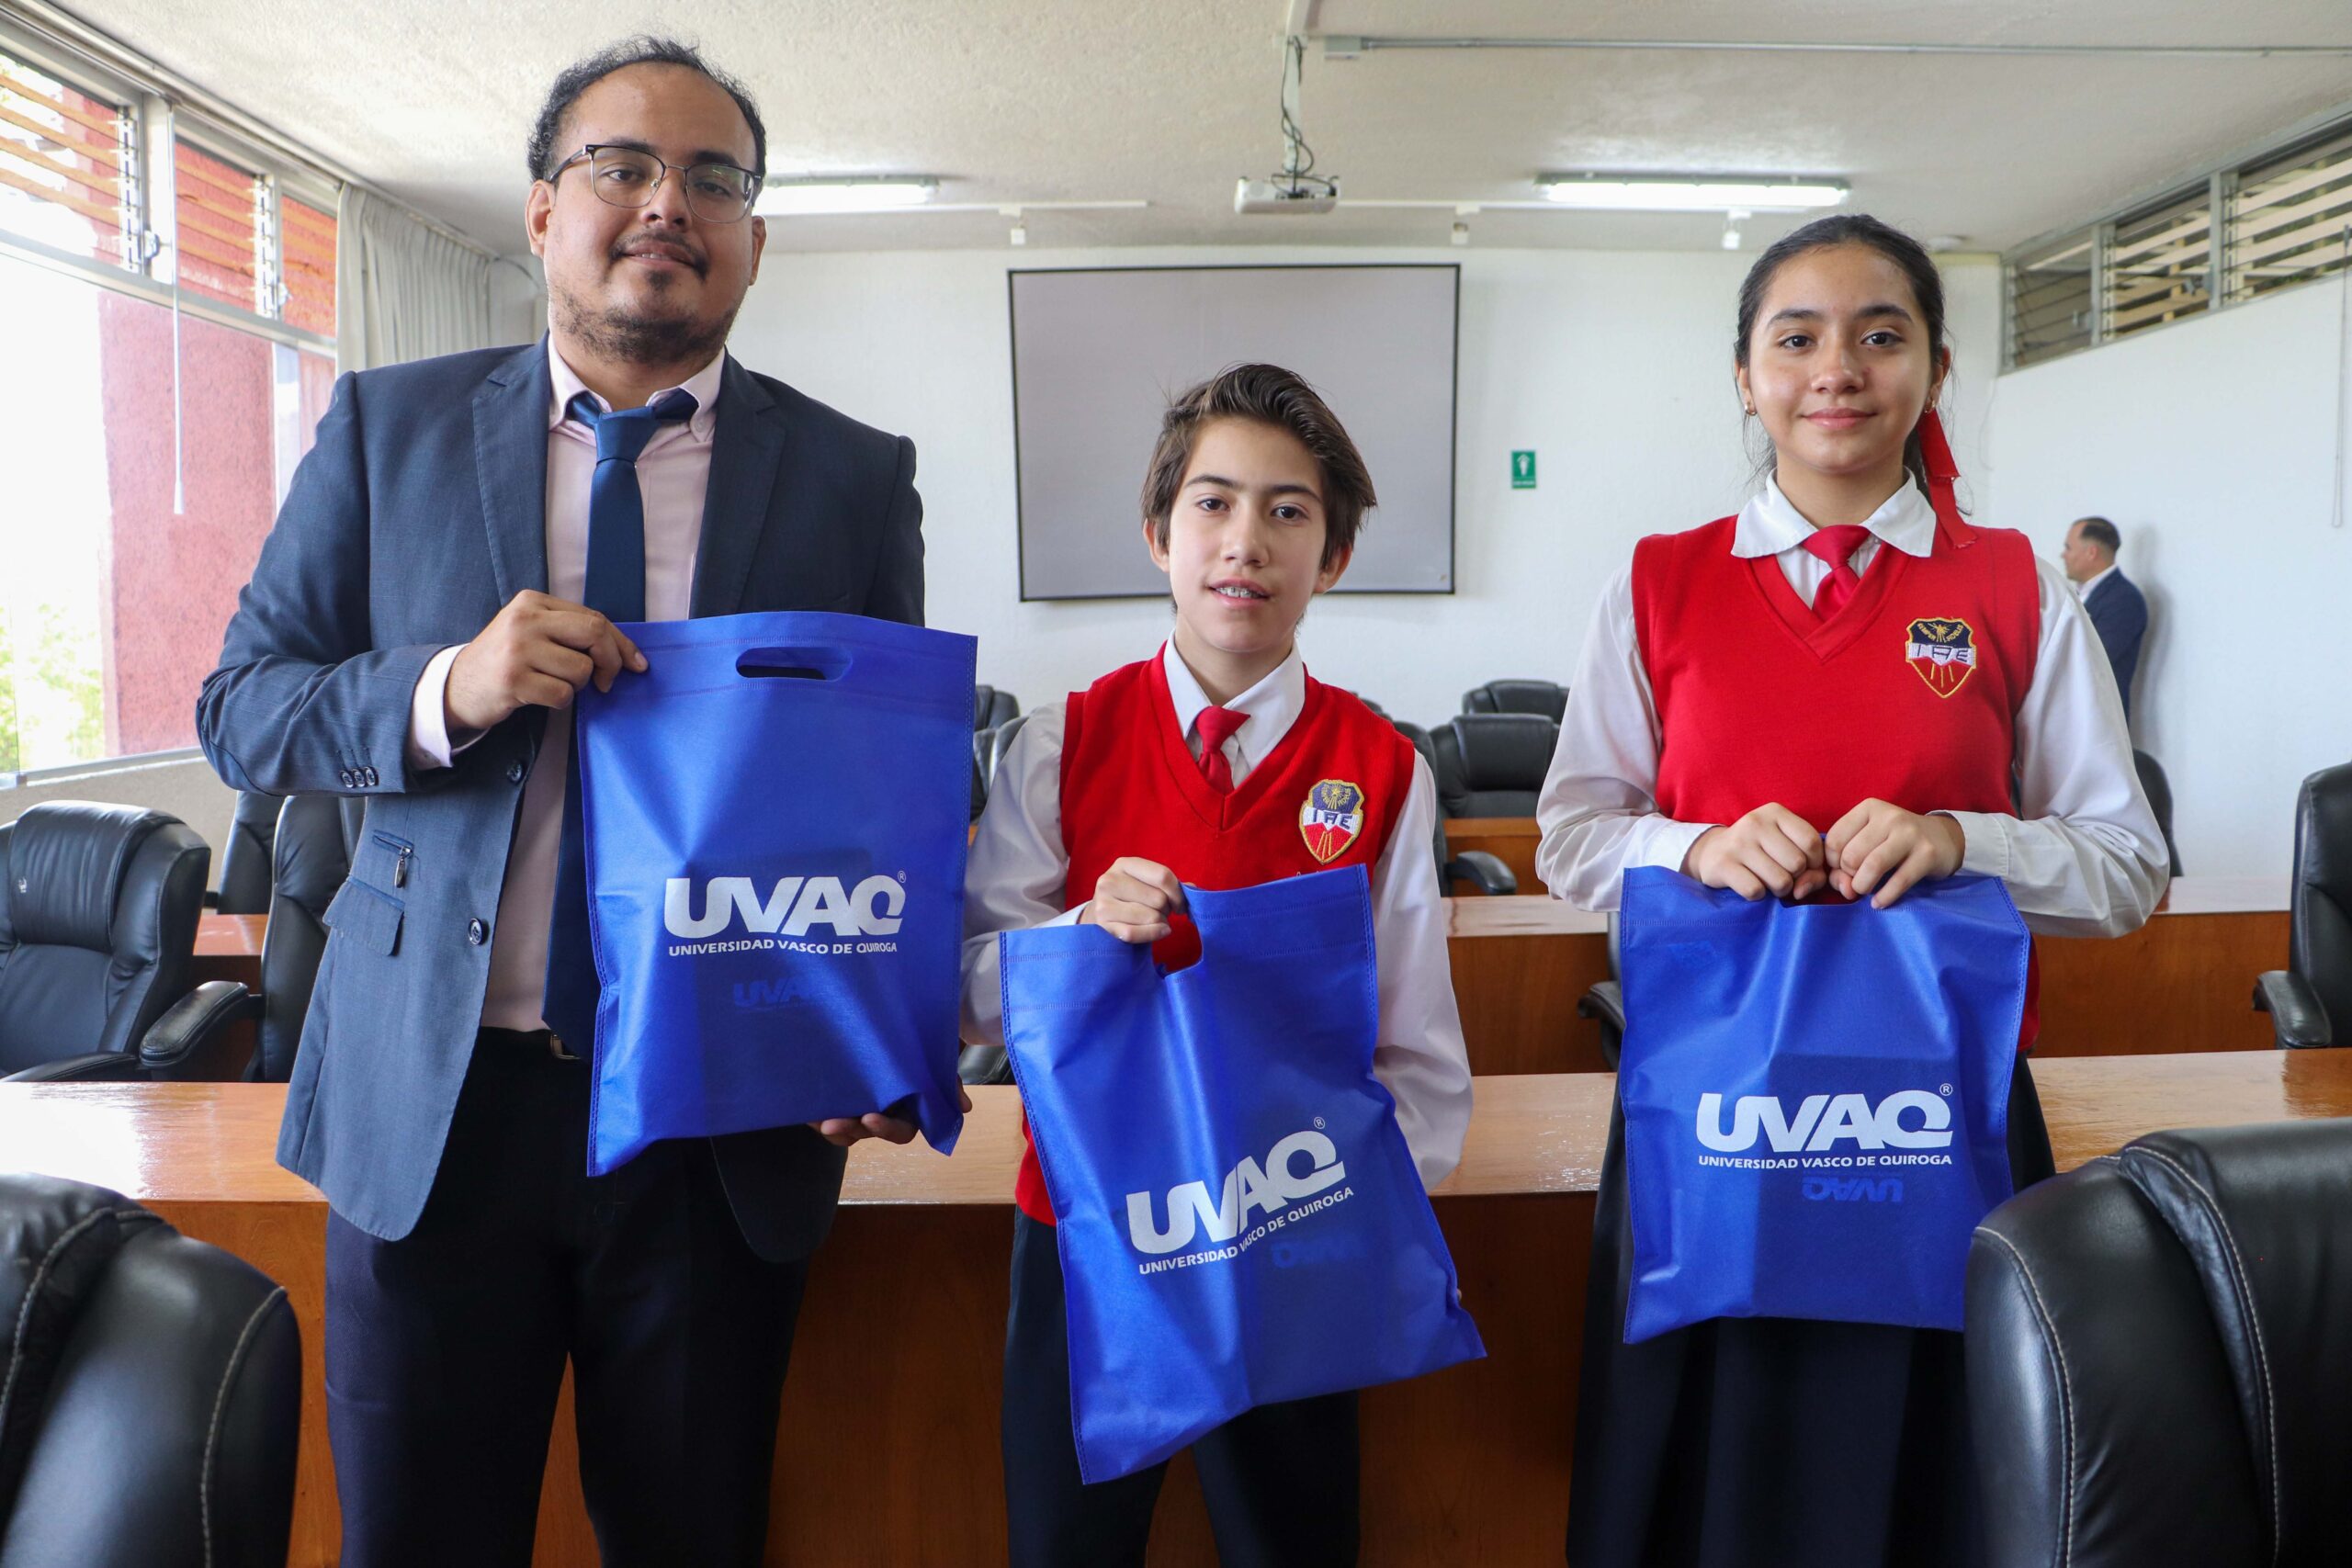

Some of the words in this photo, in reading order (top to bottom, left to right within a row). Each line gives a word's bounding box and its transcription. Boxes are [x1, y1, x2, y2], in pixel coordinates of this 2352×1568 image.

[669, 939, 774, 956] UNIVERSIDAD
[778, 940, 829, 954] VASCO
[832, 943, 853, 954] DE
[856, 942, 898, 953] QUIROGA
[1698, 1155, 1798, 1169] UNIVERSIDAD
[1802, 1157, 1853, 1168] VASCO
[1857, 1156, 1876, 1167] DE
[1880, 1155, 1952, 1166] QUIROGA
[1138, 1246, 1238, 1275] UNIVERSIDAD
[1239, 1225, 1266, 1253] VASCO
[1268, 1216, 1286, 1233] DE
[1288, 1187, 1354, 1222] QUIROGA
